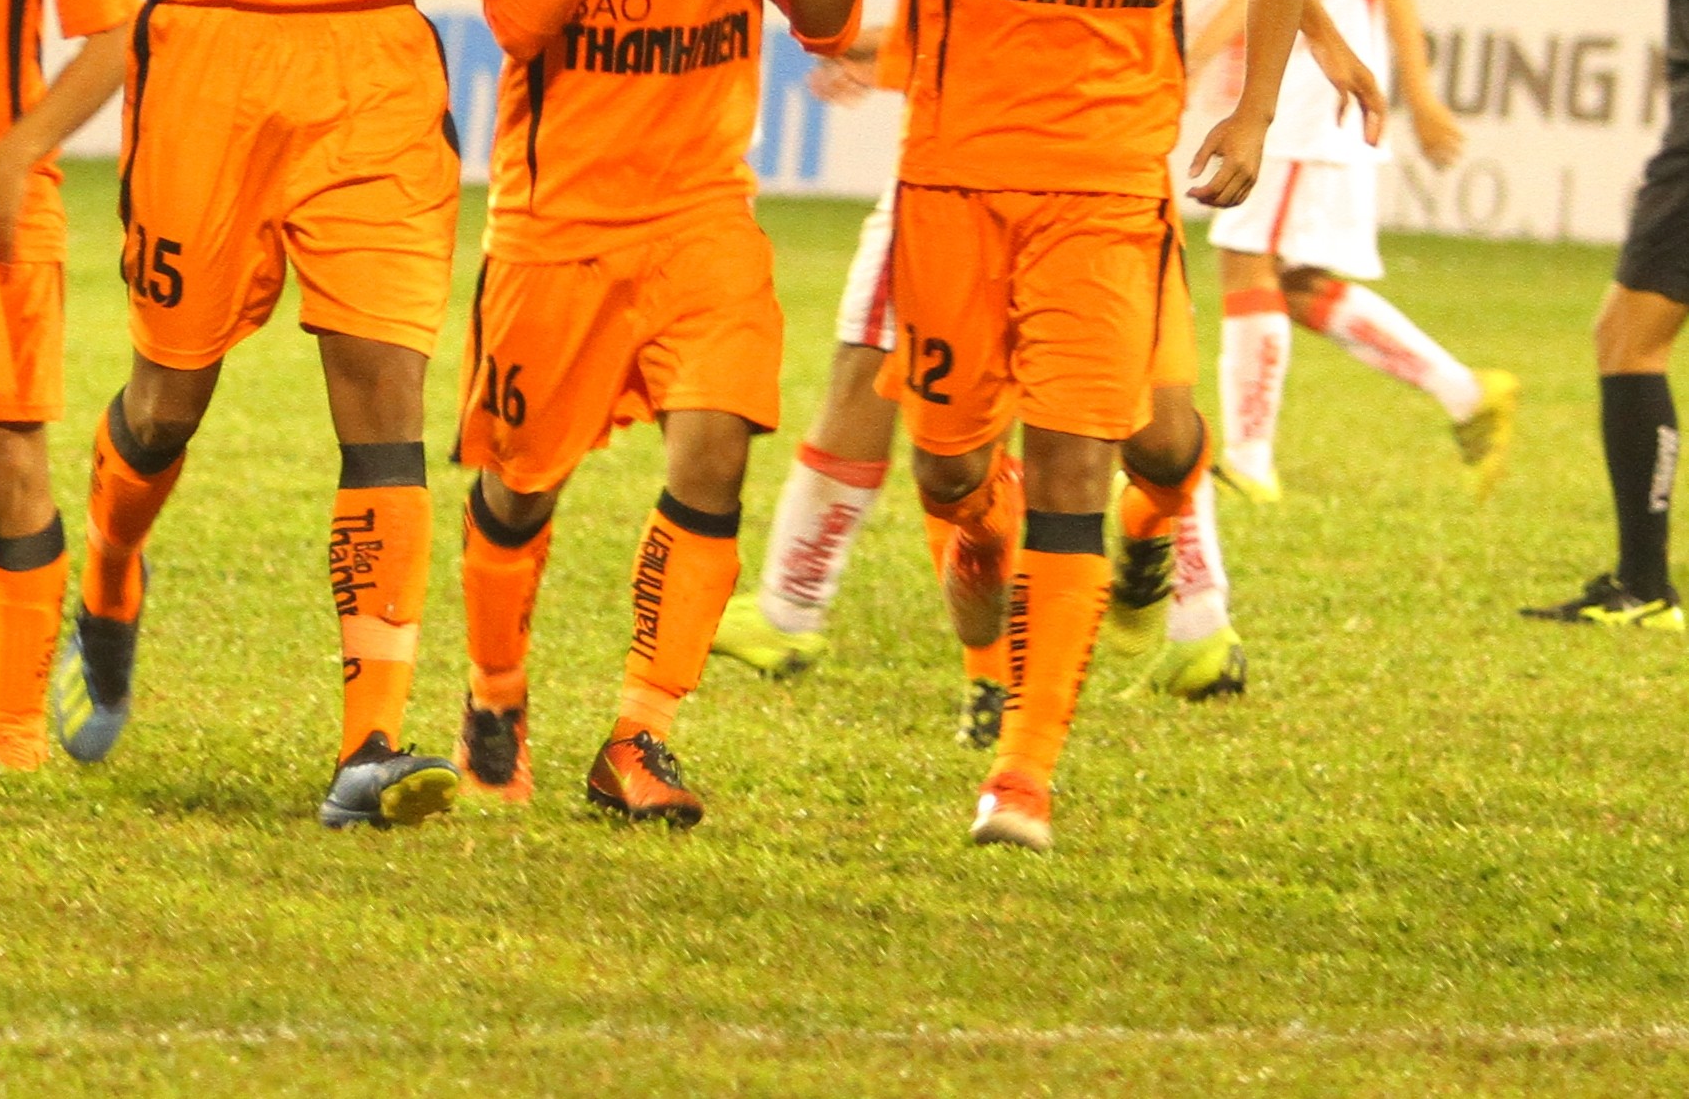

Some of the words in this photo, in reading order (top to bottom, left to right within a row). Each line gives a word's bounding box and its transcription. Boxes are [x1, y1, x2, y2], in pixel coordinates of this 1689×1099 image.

[132, 223, 184, 309] 15
[481, 353, 527, 428] 16
[906, 322, 954, 405] 12
